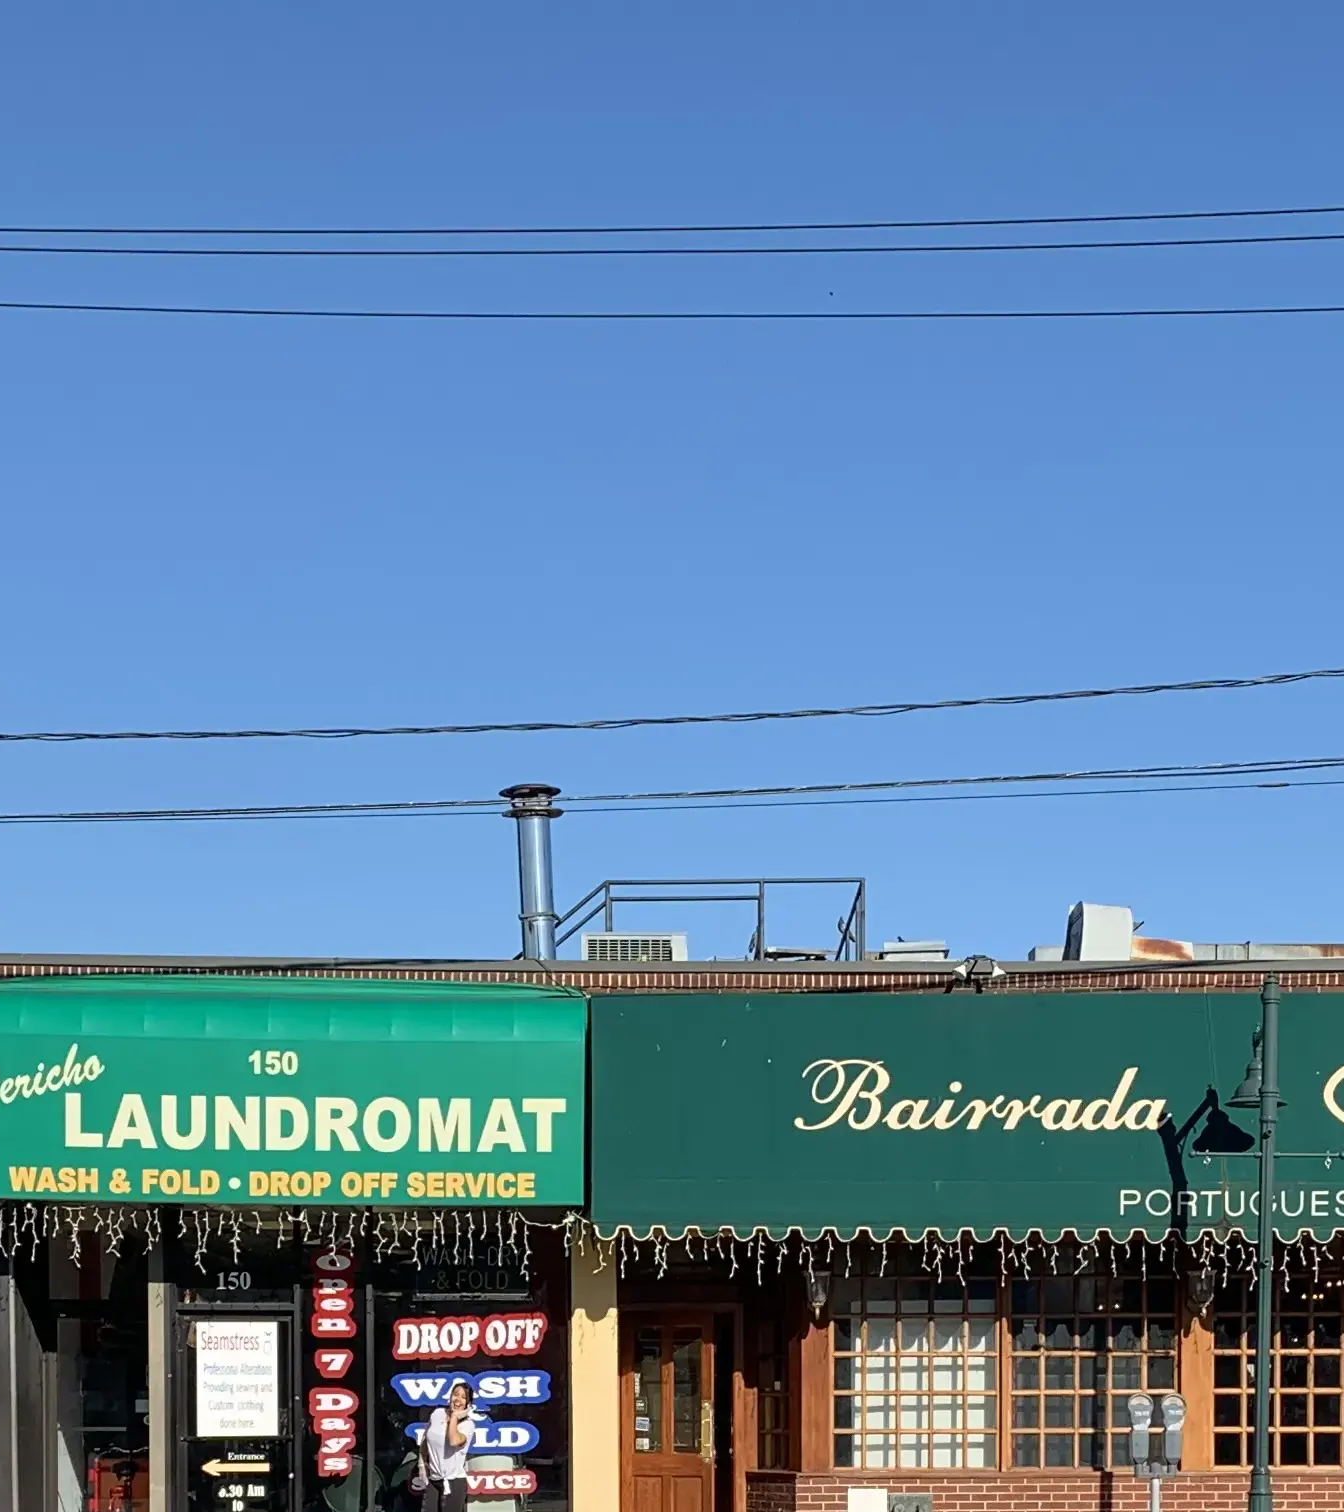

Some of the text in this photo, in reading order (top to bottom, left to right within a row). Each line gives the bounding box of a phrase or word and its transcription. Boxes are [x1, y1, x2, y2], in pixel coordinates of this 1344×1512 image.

[247, 1051, 299, 1076] 150
[794, 1059, 1172, 1131] Bairrada
[64, 1092, 567, 1153] LAUNDROMAT
[9, 1167, 536, 1198] WASH & FOLD DROP OFF SERVICE
[216, 1271, 252, 1291] 150
[436, 1270, 509, 1290] & FOLD
[316, 1254, 352, 1331] Open
[201, 1331, 260, 1351] Seamstress
[397, 1318, 544, 1354] DROP OFF
[321, 1354, 348, 1371] 7
[315, 1393, 354, 1471] Days
[414, 1427, 530, 1448] LD
[228, 1452, 265, 1461] Entrance
[247, 1484, 265, 1497] Am
[411, 1474, 532, 1491] SVICE
